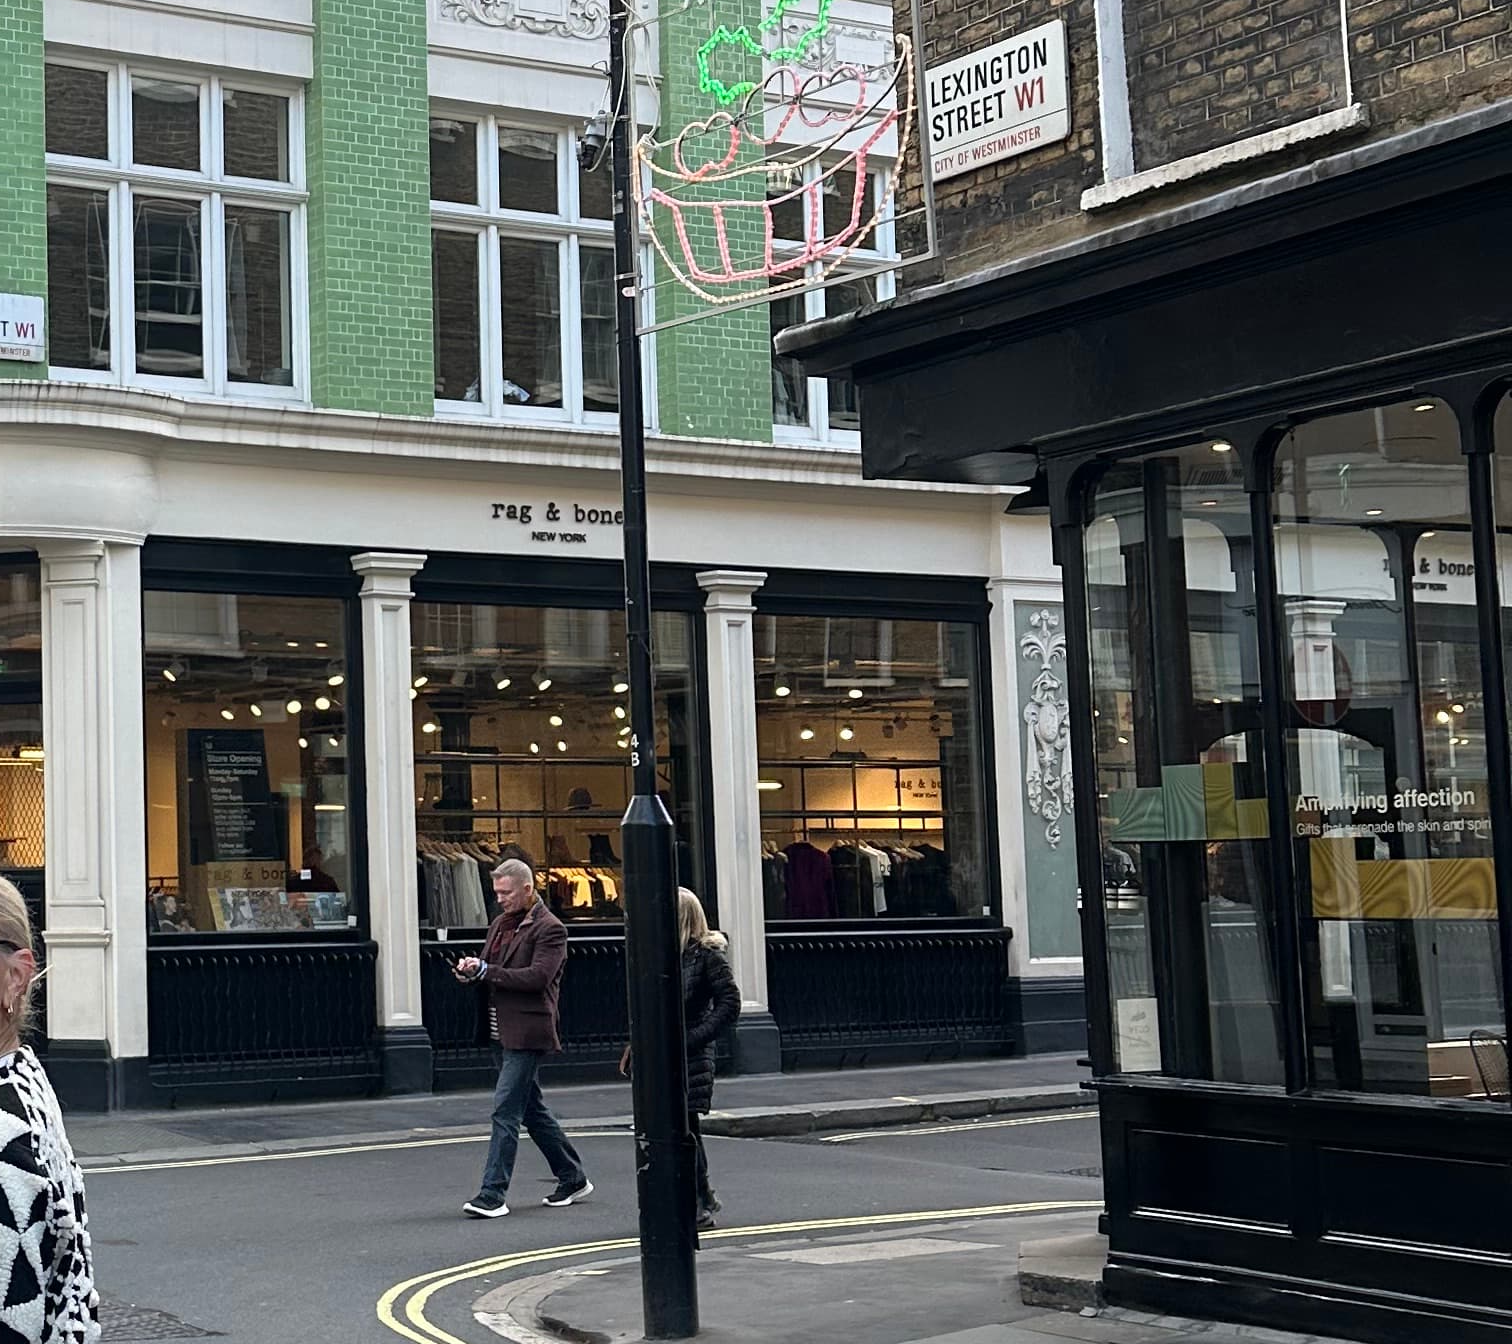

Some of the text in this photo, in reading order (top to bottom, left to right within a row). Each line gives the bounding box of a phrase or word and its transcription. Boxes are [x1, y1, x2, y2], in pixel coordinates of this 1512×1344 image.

[930, 37, 1048, 109] LEXINGTON
[932, 75, 1045, 143] STREET W1
[934, 125, 1041, 174] CITY OF WESTMINSTER
[15, 321, 35, 339] W1
[491, 502, 624, 525] rag & bone
[531, 531, 587, 543] NEW YORK
[1295, 787, 1475, 815] Amplifying affection
[1296, 822, 1321, 836] Gifts
[1397, 819, 1415, 833] the
[1417, 818, 1441, 832] skin
[1443, 817, 1465, 831] and
